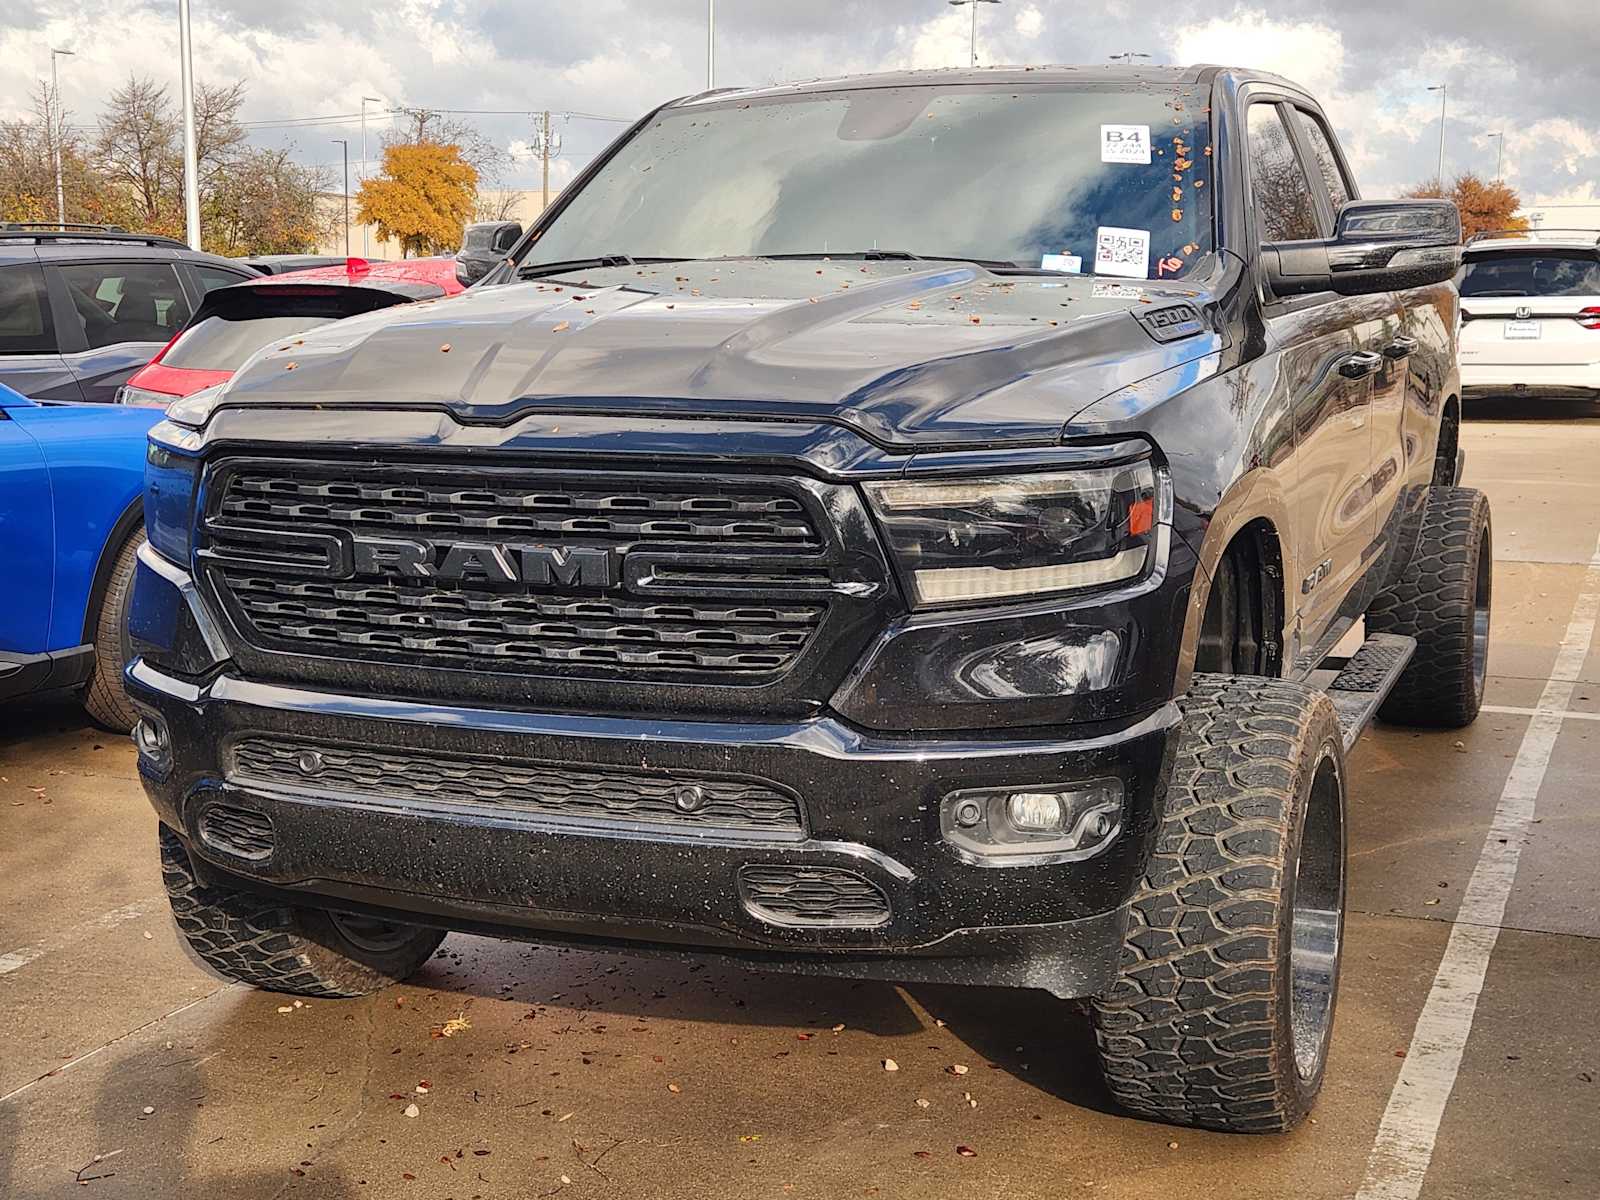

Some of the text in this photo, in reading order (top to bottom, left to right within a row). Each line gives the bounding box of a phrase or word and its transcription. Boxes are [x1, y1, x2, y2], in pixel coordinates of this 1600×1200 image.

[1106, 131, 1143, 143] B4
[1145, 307, 1192, 328] 1500
[354, 537, 613, 587] RAM
[1301, 558, 1333, 595] RAM
